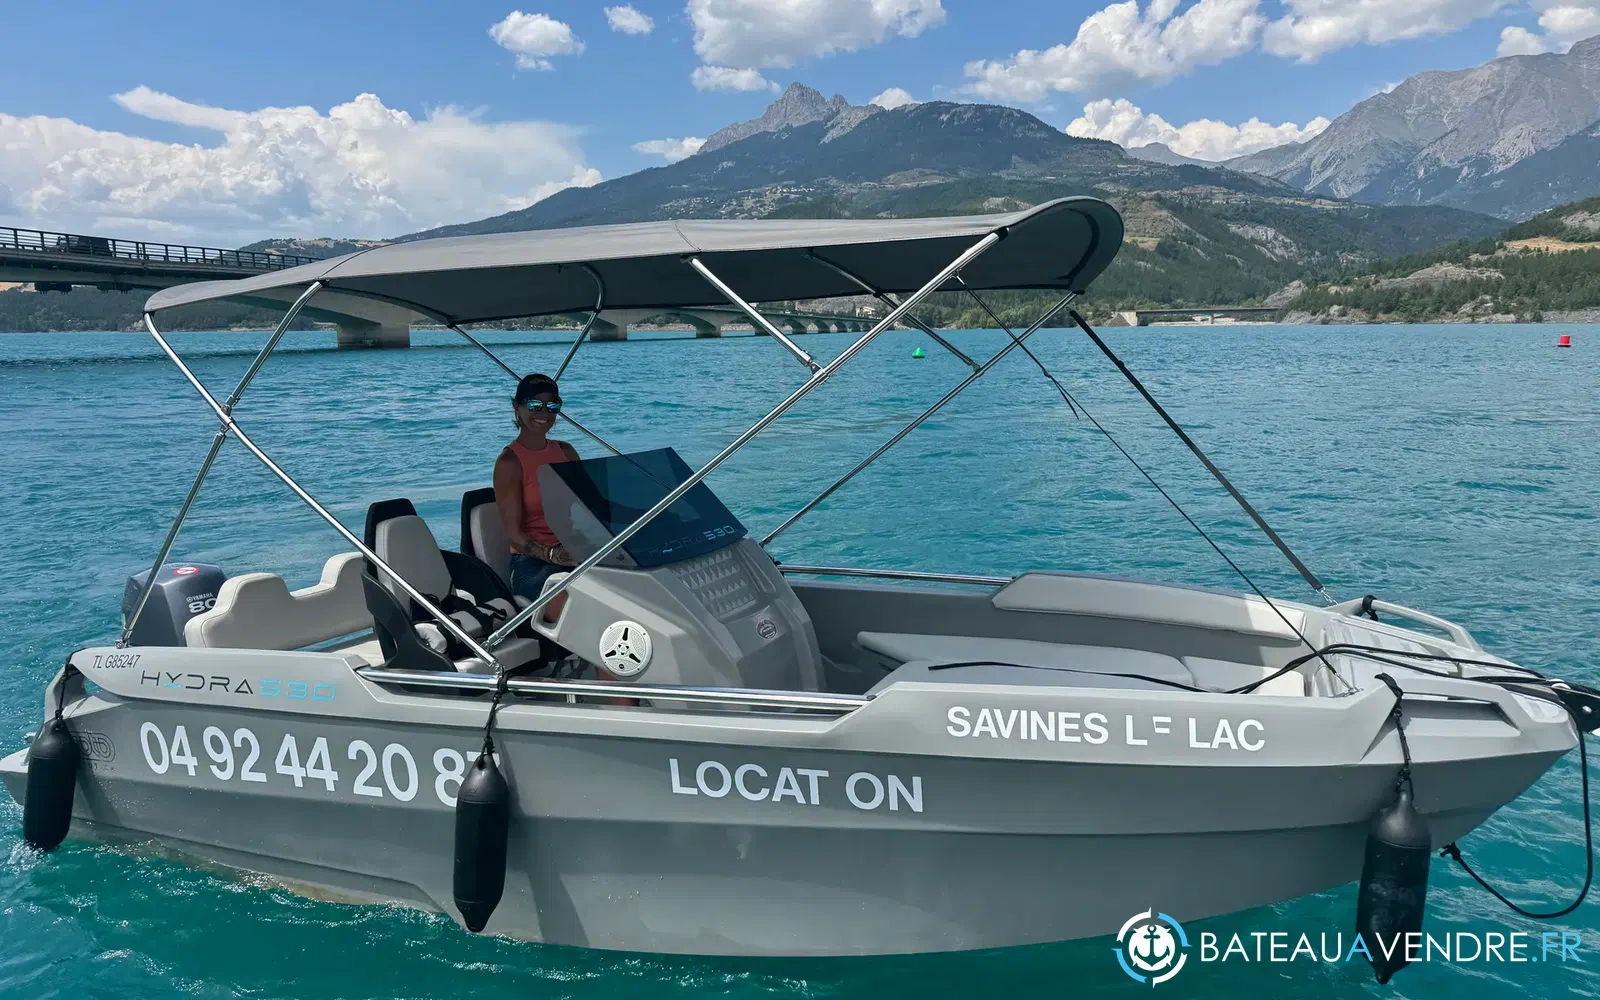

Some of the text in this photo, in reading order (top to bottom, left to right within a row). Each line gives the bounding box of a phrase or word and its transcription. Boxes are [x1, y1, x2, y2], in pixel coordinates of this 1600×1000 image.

[192, 592, 213, 601] YAMAHA
[92, 654, 141, 669] TL G85247
[946, 705, 1109, 745] SAVINES
[1188, 717, 1266, 752] LAC
[140, 721, 198, 776] 04
[202, 725, 268, 782] 92
[274, 733, 339, 792] 44
[347, 739, 419, 802] 20
